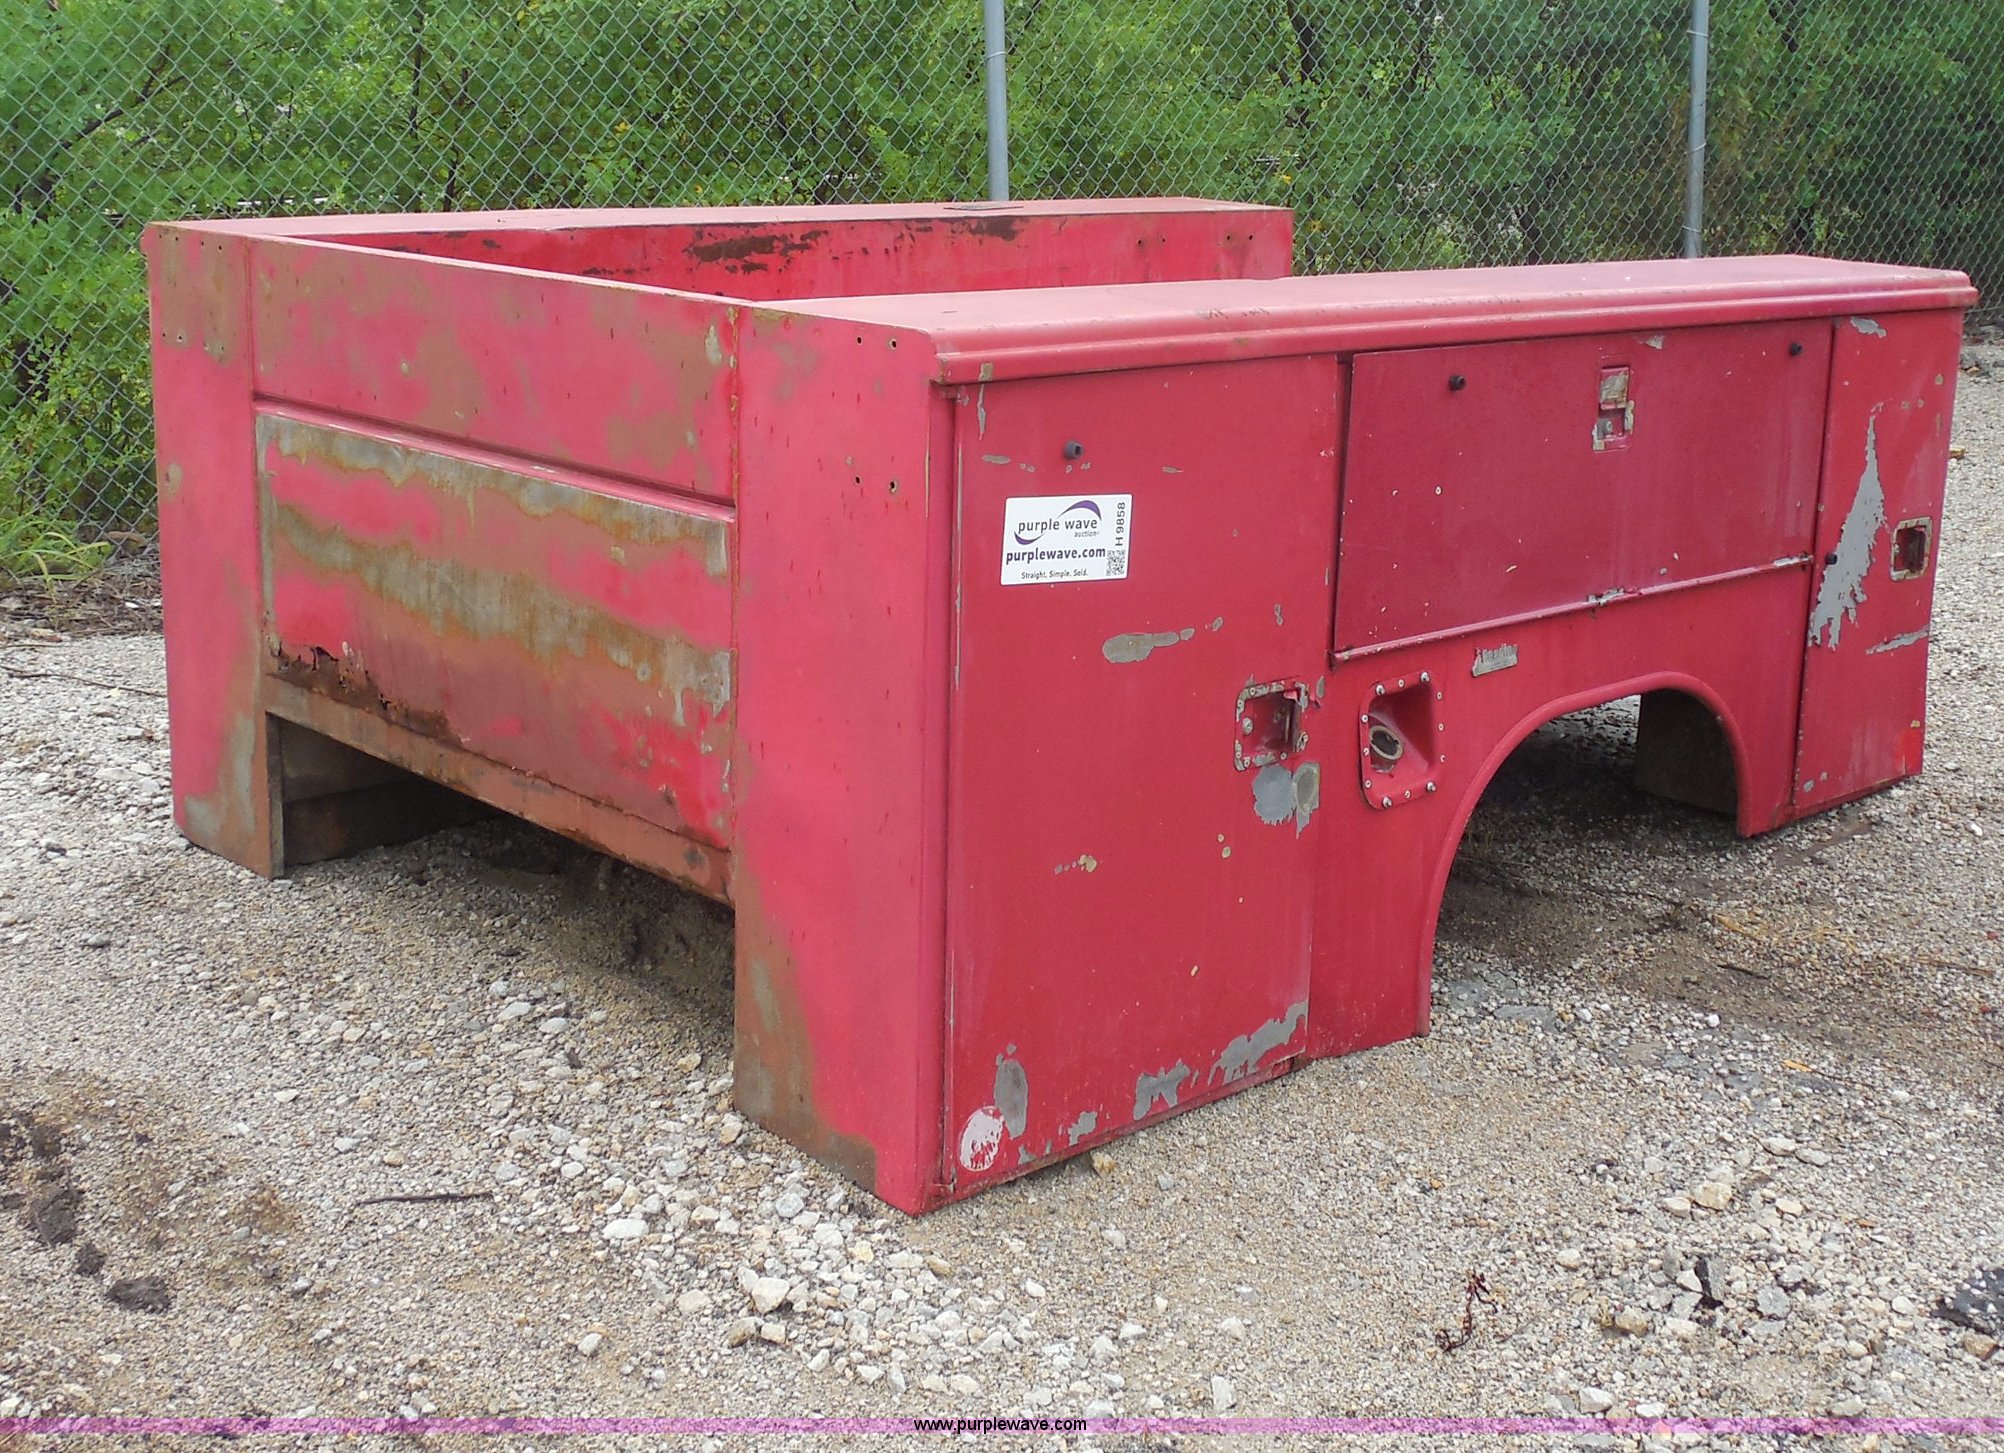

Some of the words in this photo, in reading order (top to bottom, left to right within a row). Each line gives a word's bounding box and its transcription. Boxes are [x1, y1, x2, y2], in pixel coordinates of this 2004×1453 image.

[1018, 518, 1060, 534] purple
[1064, 519, 1098, 530] wave
[1116, 502, 1126, 534] 9858
[1115, 536, 1124, 547] H
[1006, 547, 1106, 565] purplewave.com
[1021, 570, 1047, 580] Straight.
[1048, 569, 1072, 578] Simple.
